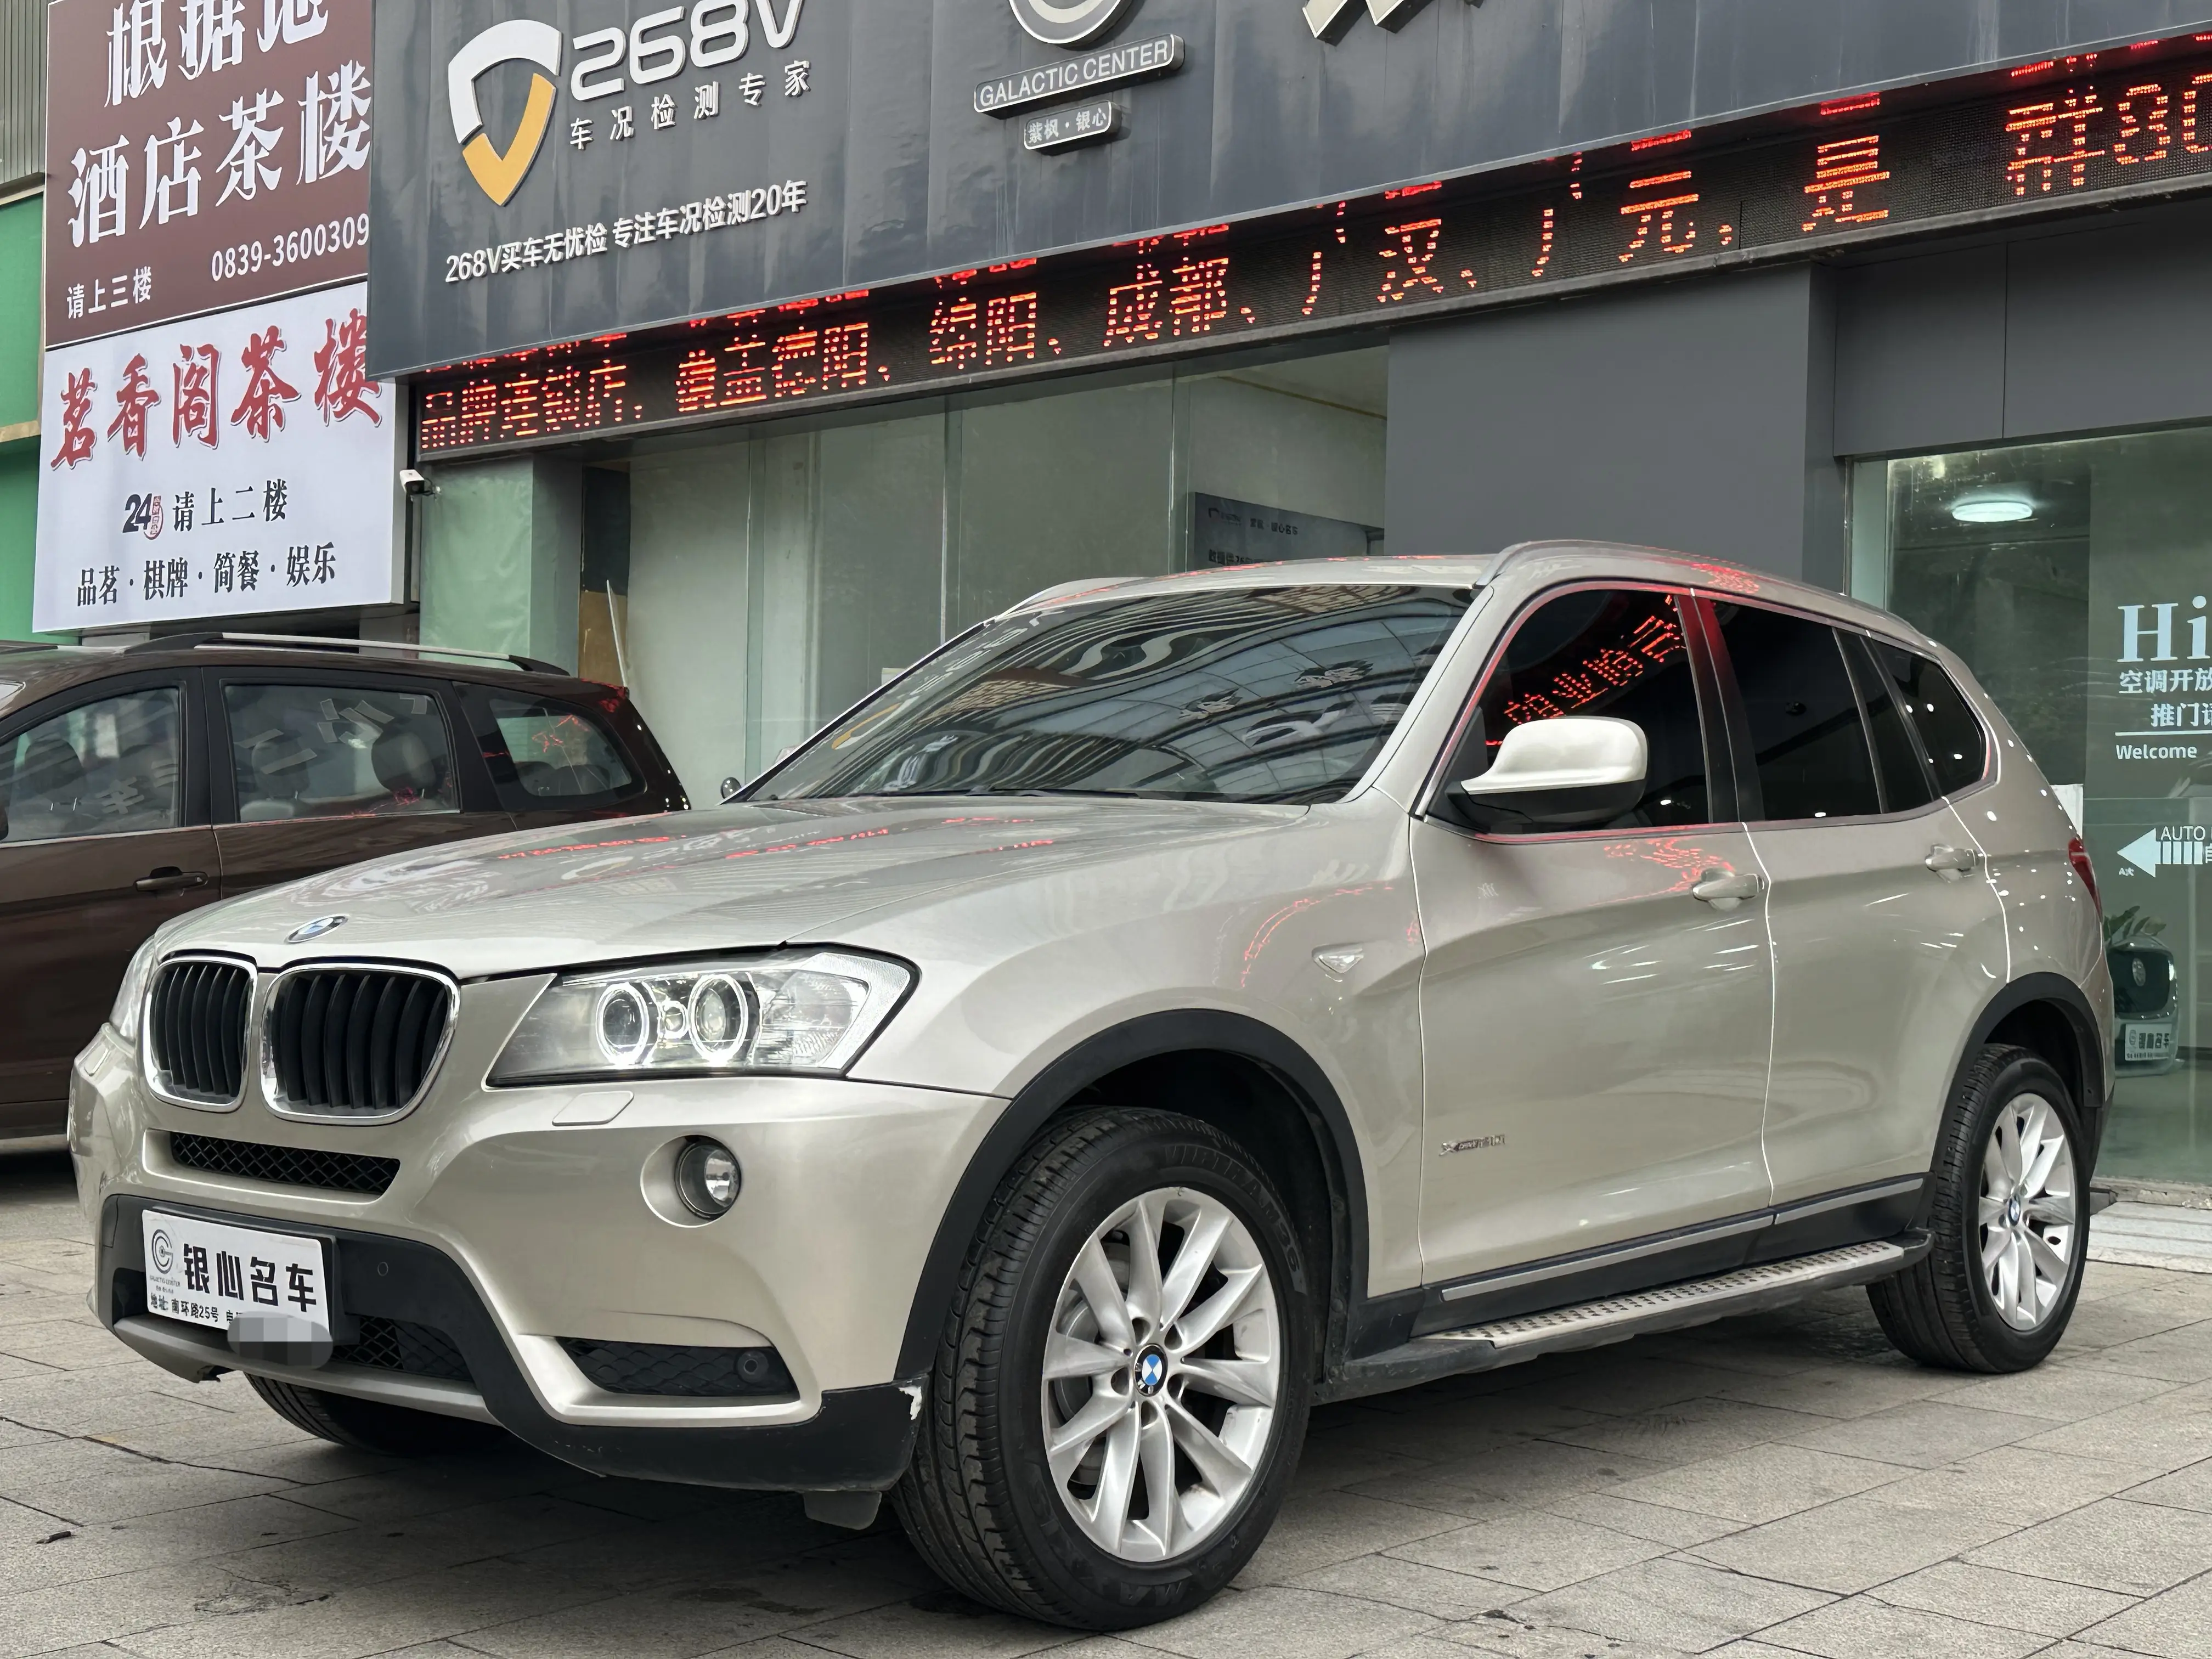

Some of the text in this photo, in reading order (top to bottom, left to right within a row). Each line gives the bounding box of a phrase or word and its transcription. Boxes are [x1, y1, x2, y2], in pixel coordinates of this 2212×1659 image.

[571, 0, 804, 101] 268V
[980, 40, 1169, 107] GALACTIC CENTER
[569, 60, 810, 150] 车况检测专家
[67, 60, 372, 247] 酒店茶楼
[211, 213, 369, 281] 0839-3600309
[445, 180, 808, 283] 268V买车无忧检 专注车况检测20年
[66, 266, 152, 319] 请上三楼
[51, 308, 382, 471] 茗香阁茶楼
[122, 493, 152, 533] 24
[172, 478, 288, 532] 请上二楼
[2117, 596, 2210, 662] Hi
[2116, 744, 2197, 760] Welcome
[2161, 826, 2205, 841] AUTO
[183, 1243, 317, 1313] 银心名车
